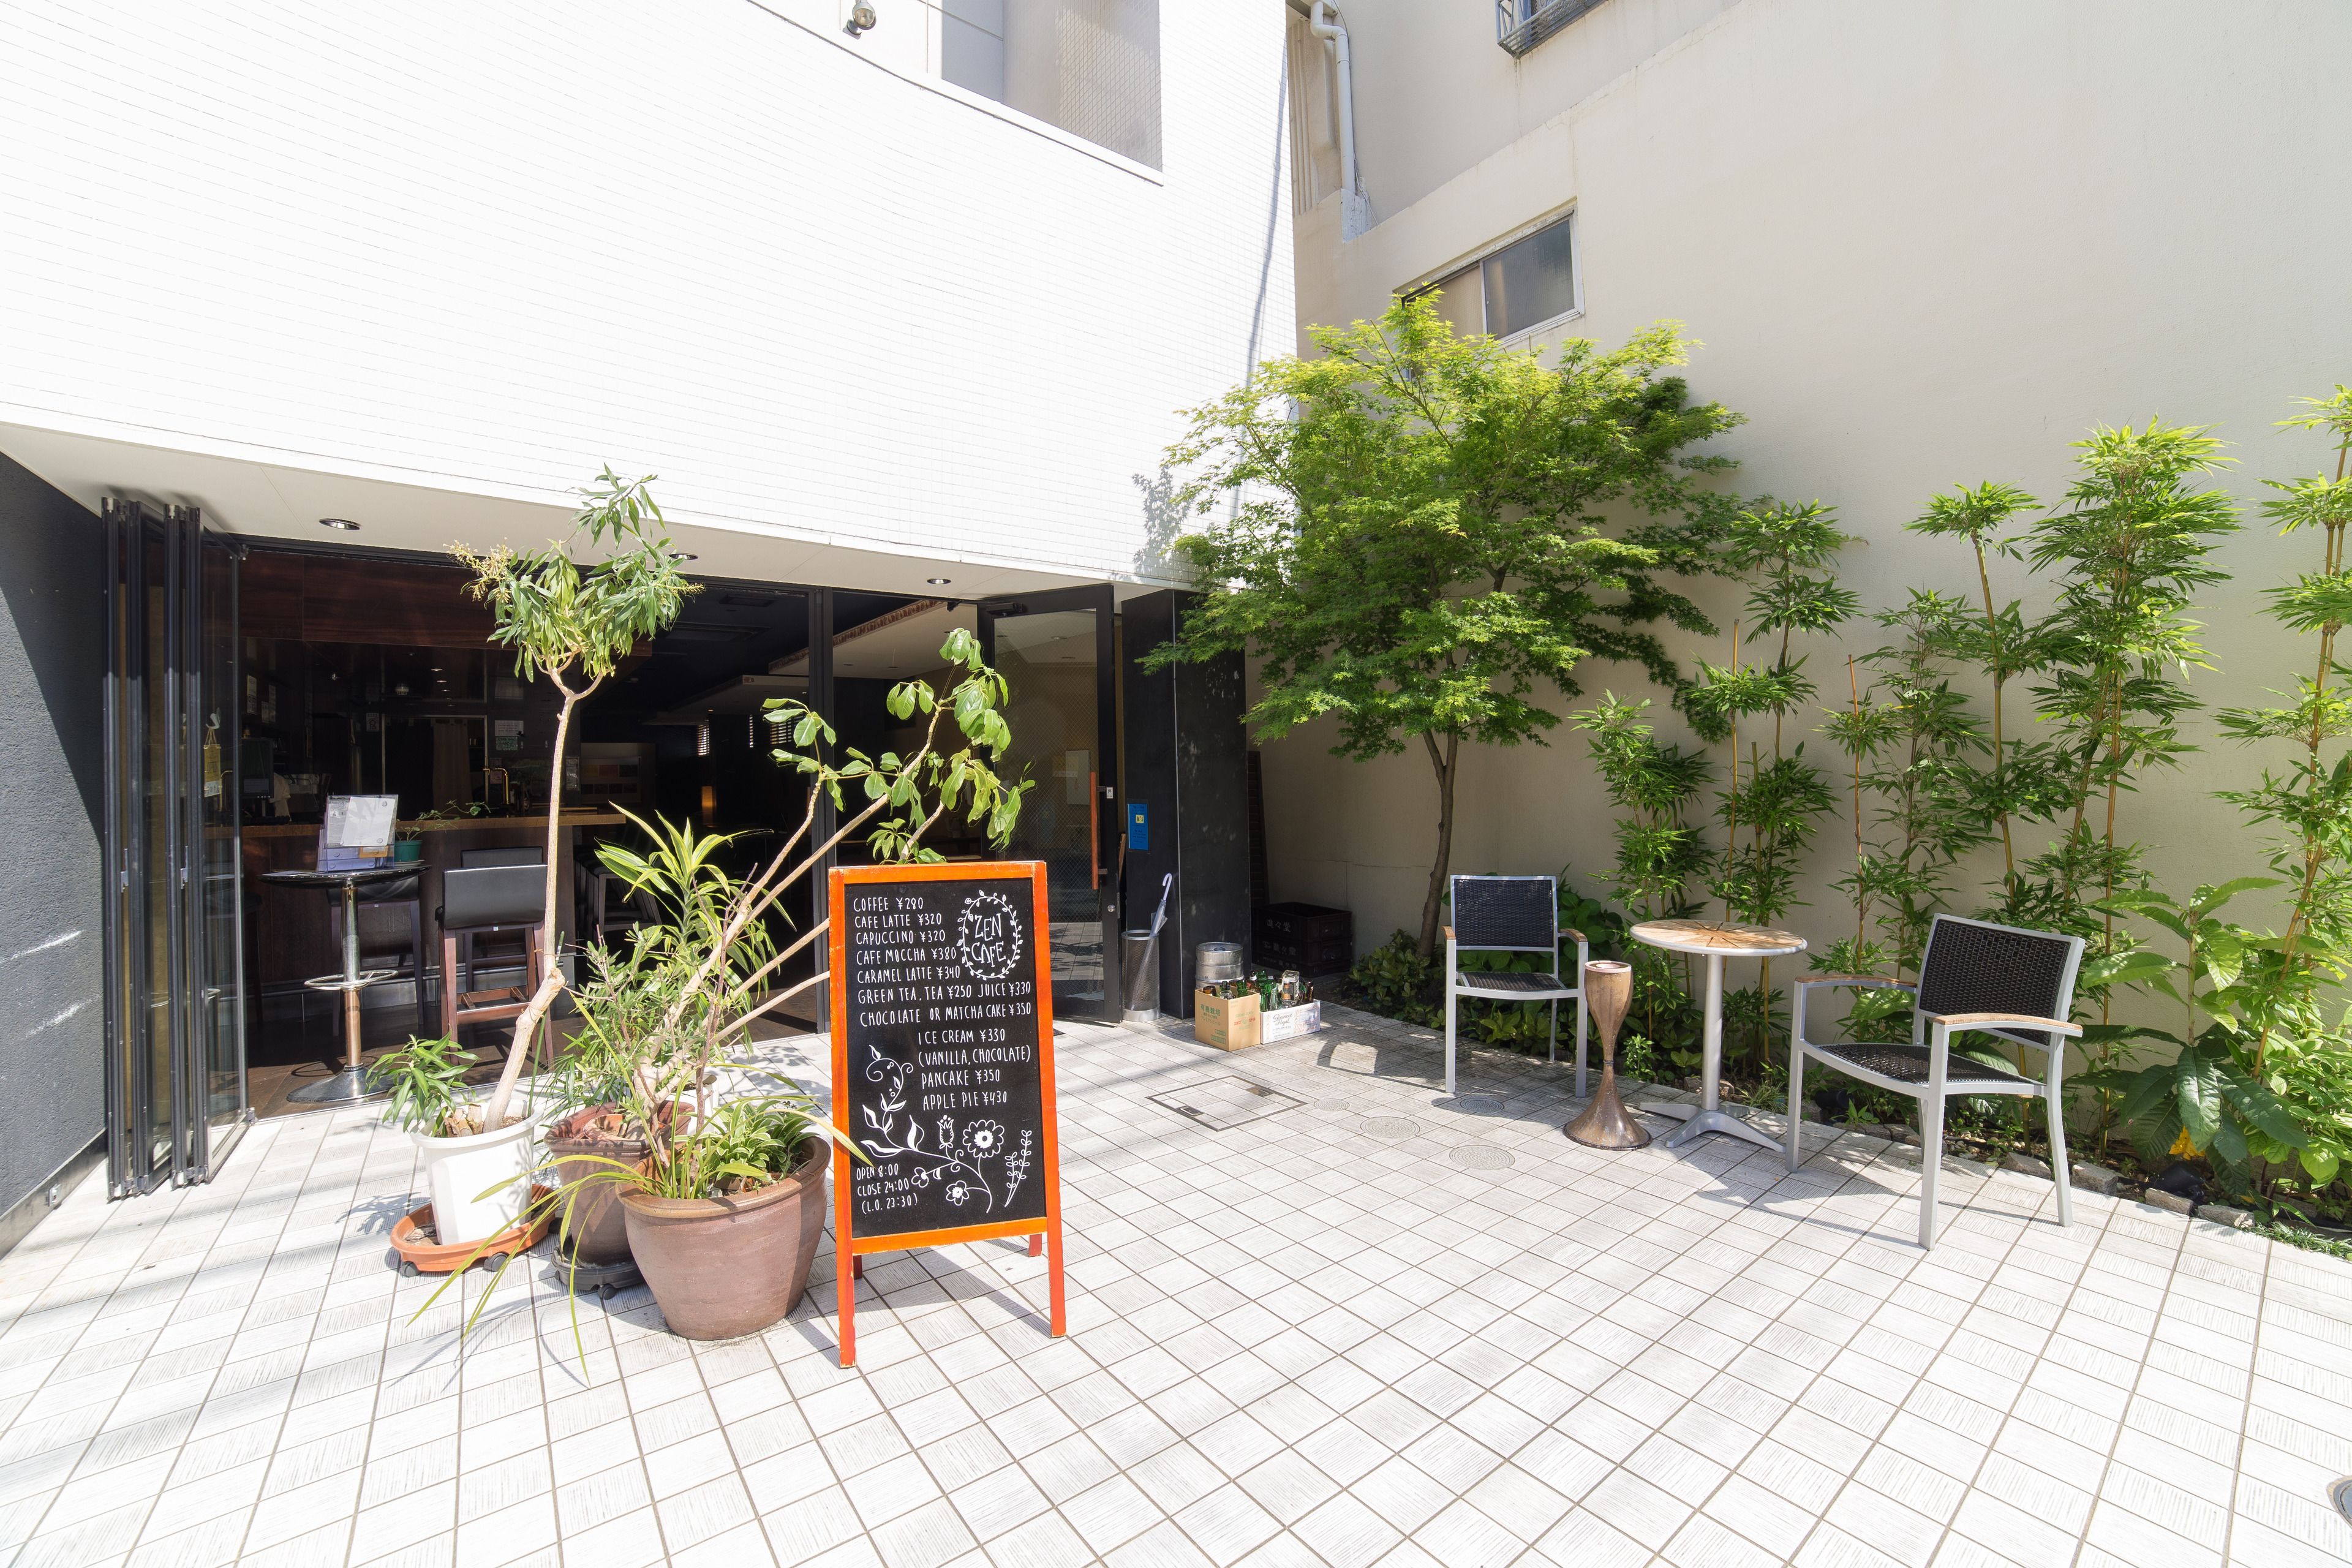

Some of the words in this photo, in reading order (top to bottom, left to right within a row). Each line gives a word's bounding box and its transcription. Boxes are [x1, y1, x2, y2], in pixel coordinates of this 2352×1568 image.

[854, 897, 888, 912] COFFEE
[896, 897, 923, 910] ¥280
[855, 916, 878, 929] CAFE
[883, 914, 910, 927] LATTE
[918, 913, 941, 925] ¥320
[974, 913, 1001, 941] ZEN
[856, 930, 913, 945] CAPUCCINO
[919, 930, 945, 942] ¥320
[857, 951, 880, 965] CAFE
[886, 948, 925, 963] MOCCHA
[931, 946, 956, 960] ¥380
[971, 941, 1006, 967] CAFE
[858, 969, 901, 983] CARAMEL
[907, 967, 932, 981] LATTE
[936, 965, 960, 979] ¥340
[858, 989, 893, 1004] GREEN
[924, 986, 943, 1000] TEA
[947, 985, 971, 999] ¥250
[978, 983, 1005, 997] JUICE
[1009, 981, 1030, 995] ¥330
[861, 1009, 920, 1027] CHOCOLATE
[930, 1008, 940, 1020] OR
[946, 1005, 982, 1020] MATCHA
[986, 1004, 1006, 1017] CAKE
[1009, 1002, 1031, 1016] ¥350
[919, 1031, 937, 1045] ICE
[942, 1030, 973, 1043] CREAM
[979, 1028, 1005, 1042] ¥330
[922, 1070, 968, 1089] PANCAKE
[975, 1069, 1000, 1084] ¥350
[924, 1093, 956, 1110] APPLE
[962, 1092, 978, 1107] PIE
[982, 1091, 1007, 1105] ¥430
[857, 1166, 875, 1180] OPEN
[878, 1163, 898, 1177] 8:00
[858, 1183, 881, 1196] CLOSE
[884, 1178, 909, 1193] 24:00
[862, 1199, 882, 1214] (L.O.
[886, 1193, 918, 1208] 23:30)
